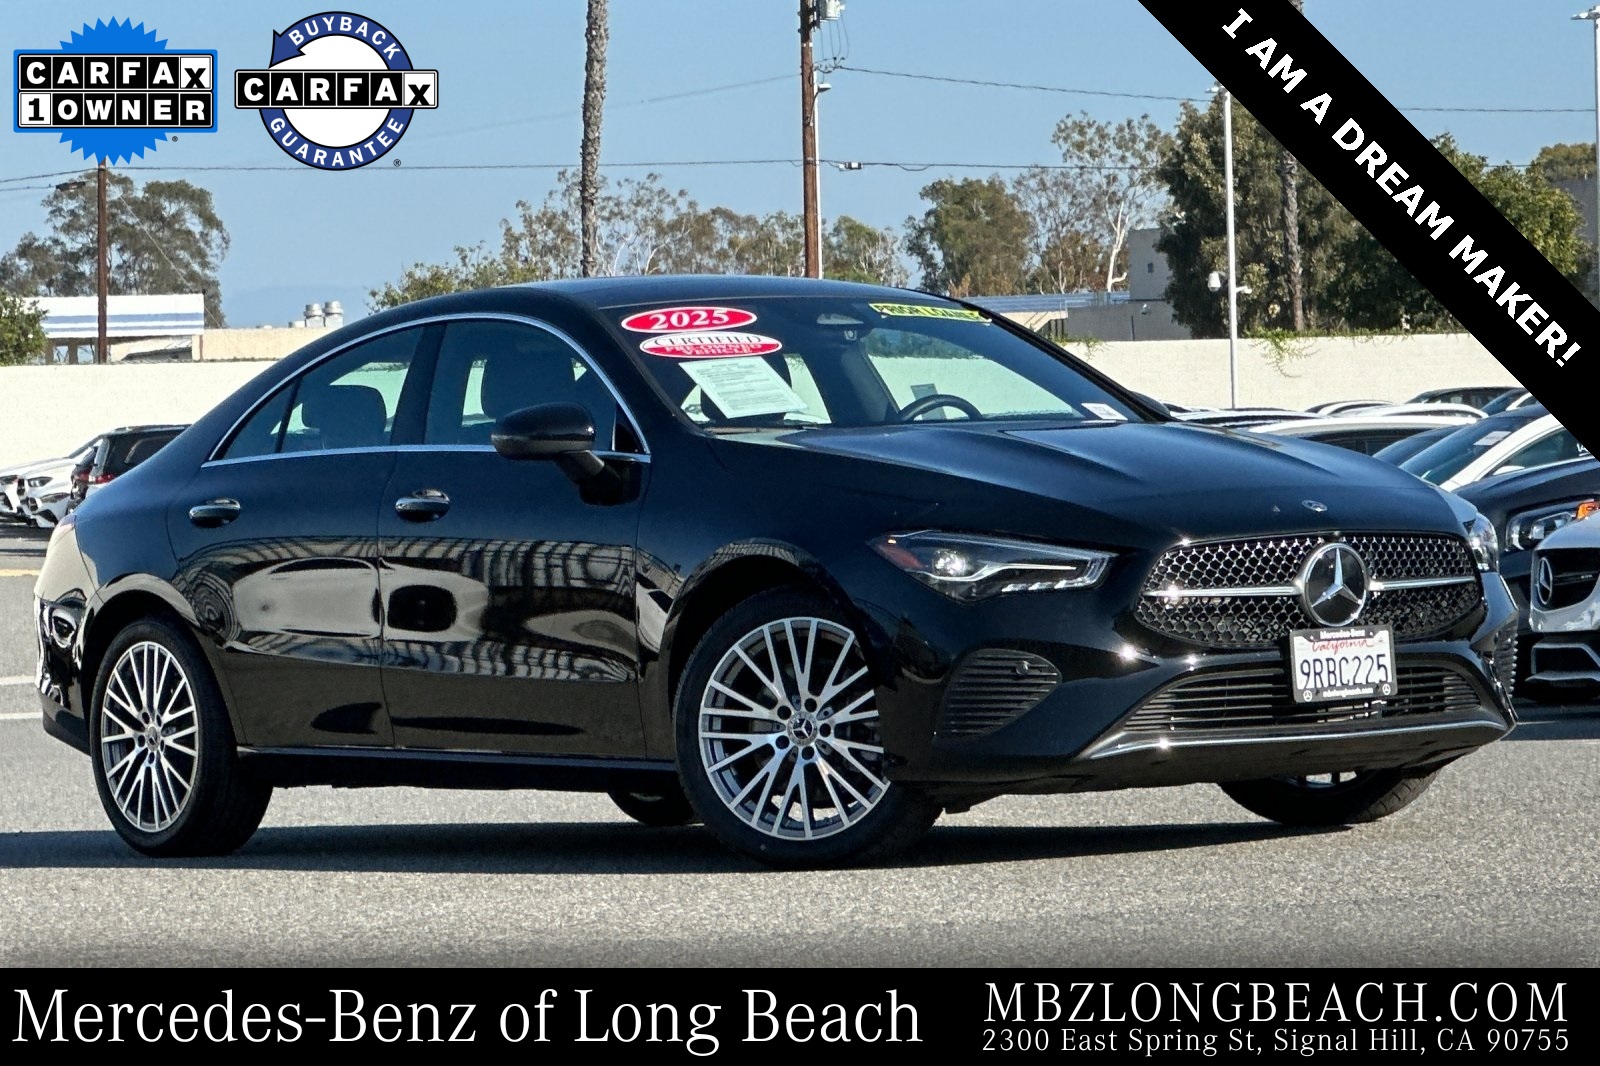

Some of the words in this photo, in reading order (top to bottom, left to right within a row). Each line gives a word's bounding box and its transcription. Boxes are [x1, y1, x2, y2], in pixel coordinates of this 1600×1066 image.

[650, 309, 730, 330] 2025
[654, 335, 762, 346] CERTIFIED
[1312, 639, 1375, 655] California
[1300, 654, 1389, 688] 9RBC225
